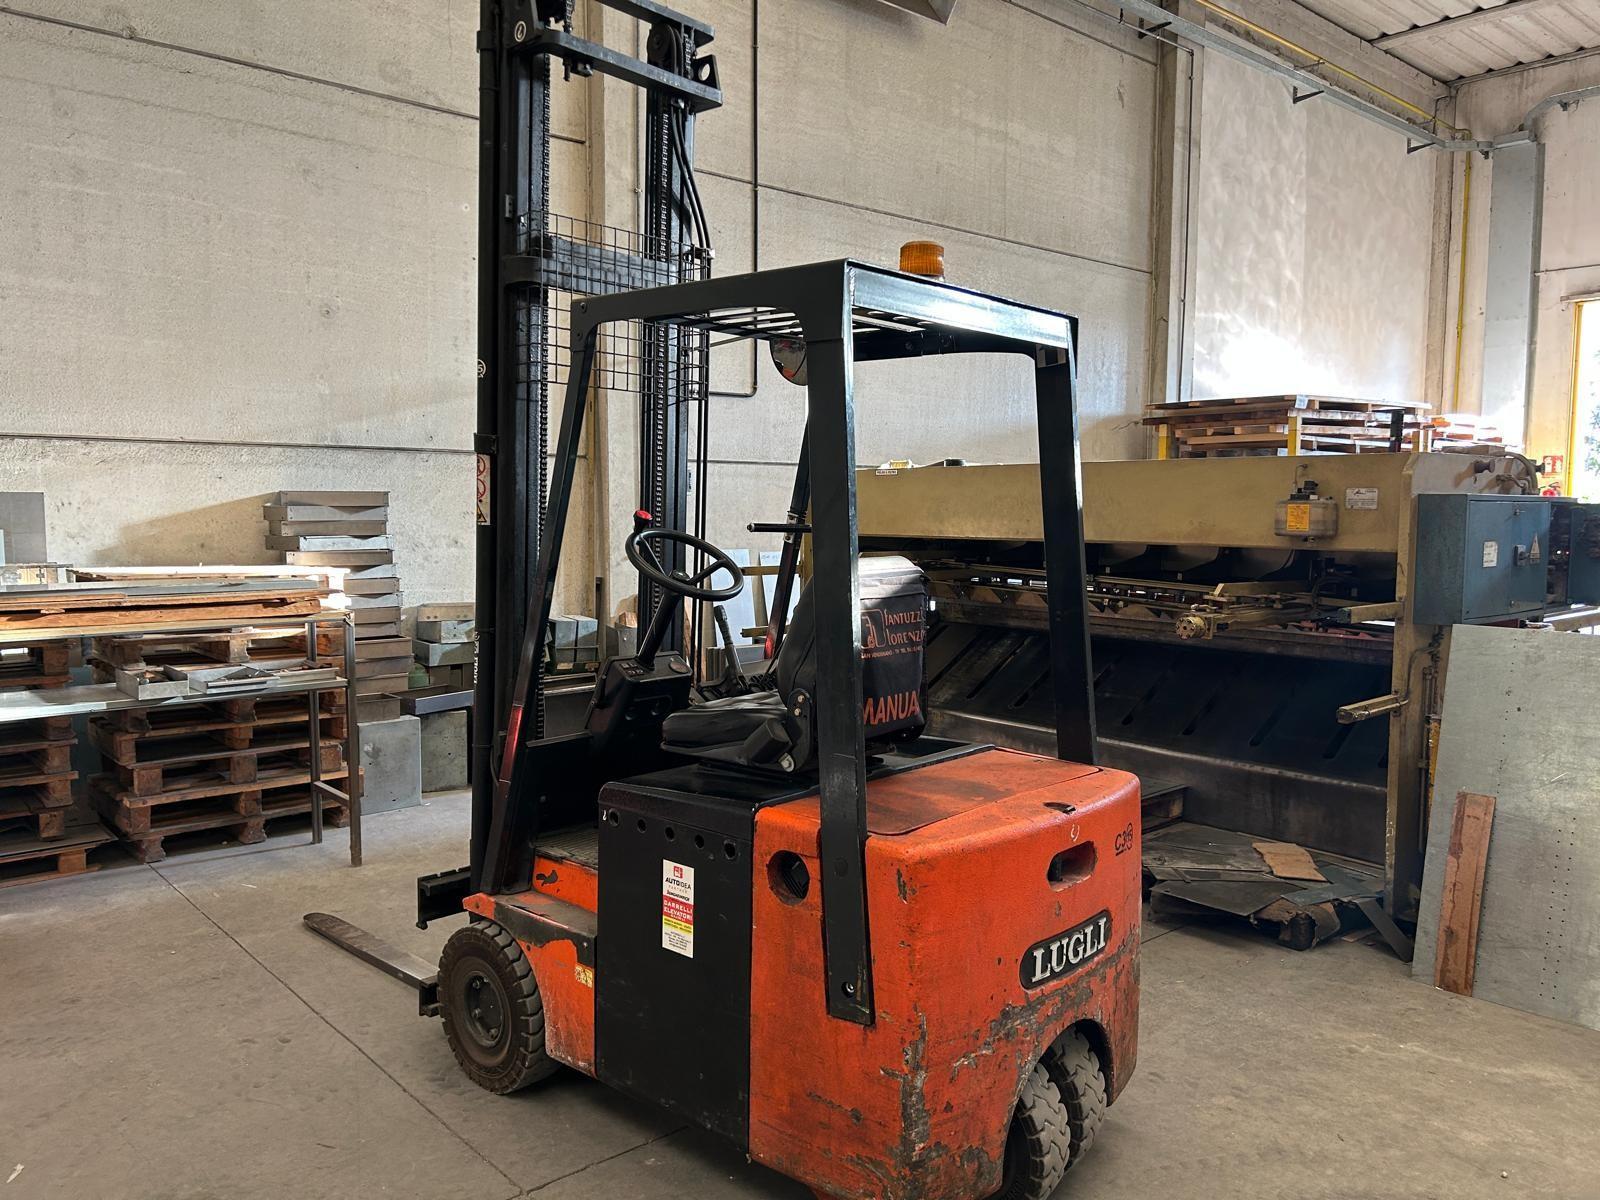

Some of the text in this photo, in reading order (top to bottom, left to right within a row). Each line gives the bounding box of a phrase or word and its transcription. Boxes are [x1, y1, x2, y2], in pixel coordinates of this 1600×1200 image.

[664, 900, 693, 914] CARRELLI
[664, 907, 693, 920] ELEVATORI
[1032, 917, 1107, 982] LUGLI
